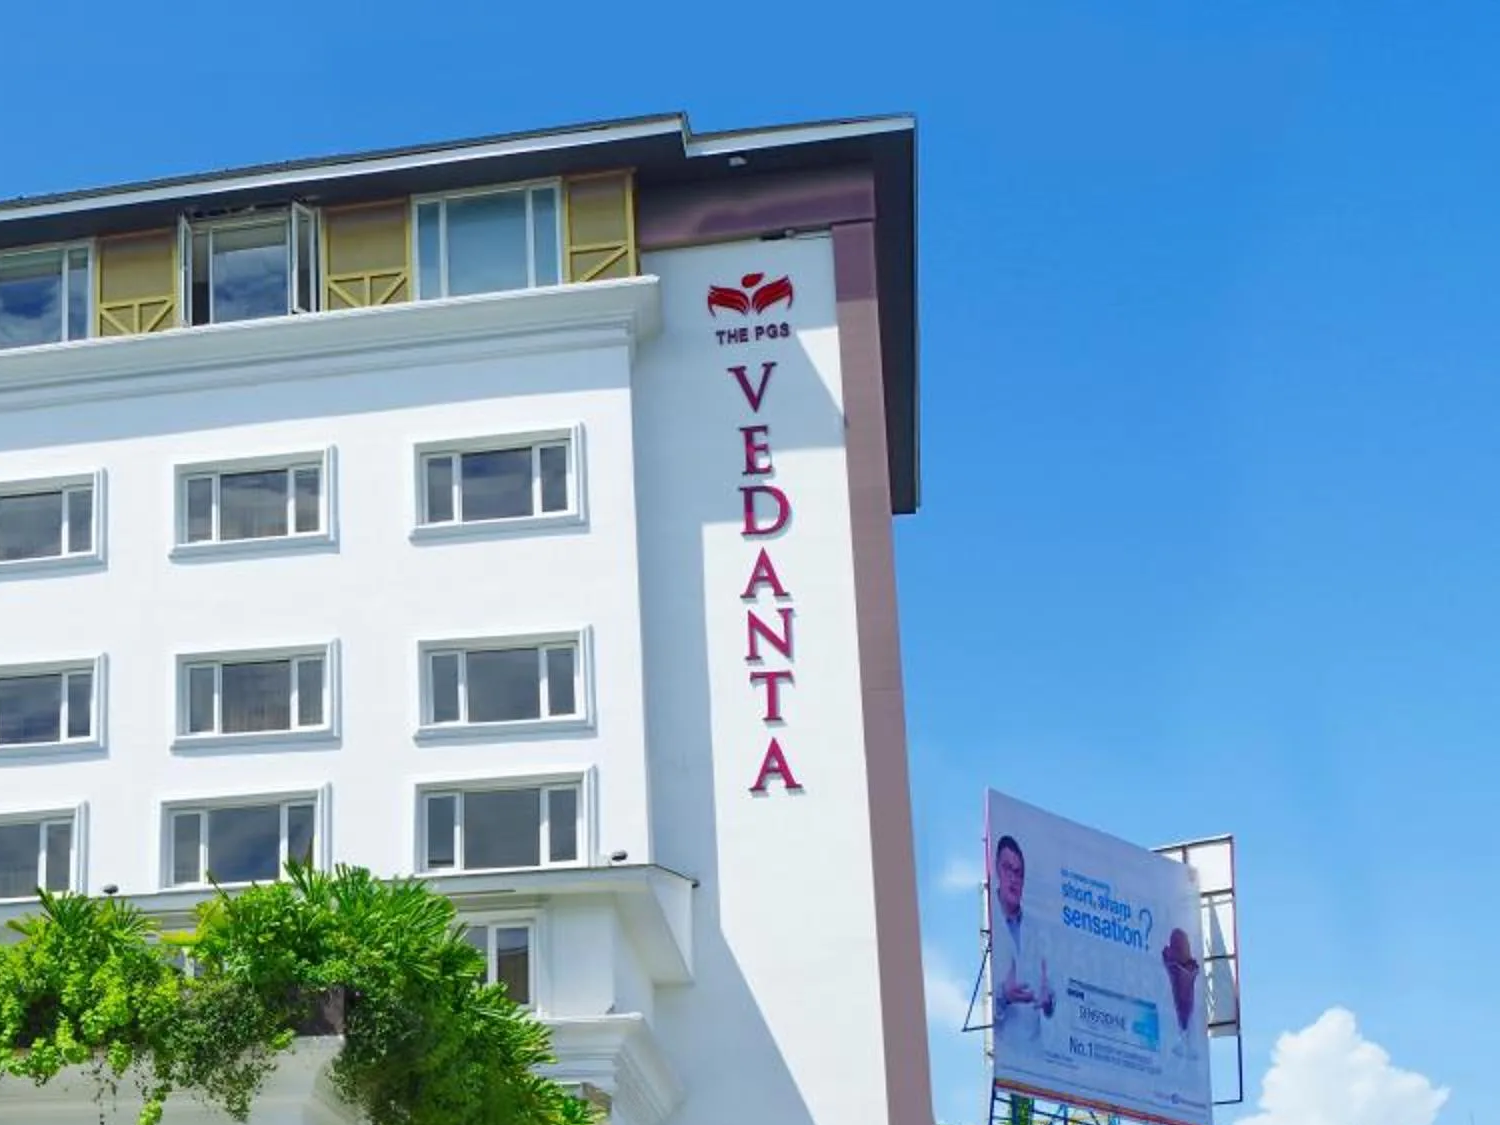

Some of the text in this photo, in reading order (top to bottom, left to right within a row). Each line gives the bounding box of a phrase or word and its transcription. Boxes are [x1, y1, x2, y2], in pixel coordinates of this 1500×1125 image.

[715, 322, 790, 345] THE PGS
[727, 362, 803, 792] VEDANTA
